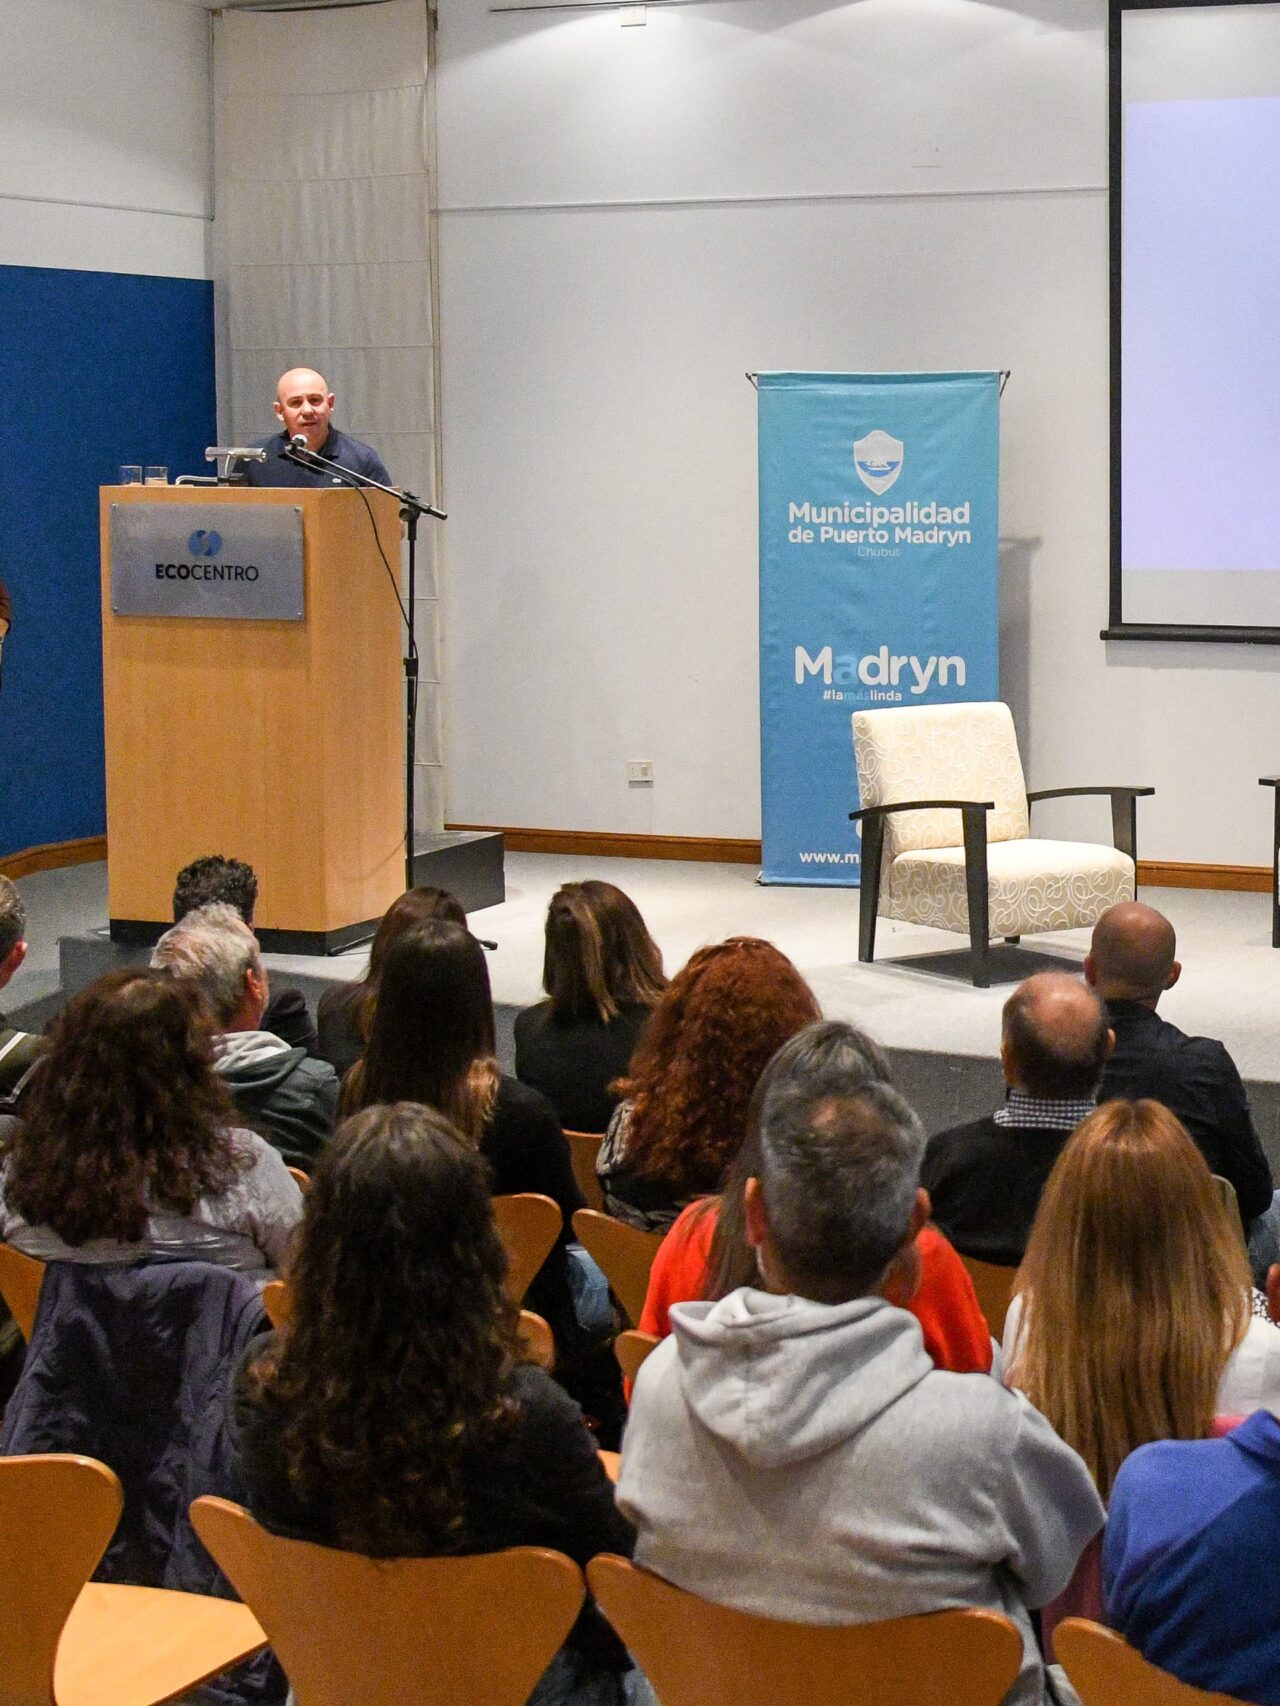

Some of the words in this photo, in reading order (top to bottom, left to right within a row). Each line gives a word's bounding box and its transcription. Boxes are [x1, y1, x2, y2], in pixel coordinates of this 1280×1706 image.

[788, 501, 970, 528] Municipalidad
[788, 526, 814, 544] de
[820, 526, 889, 544] Puerto
[895, 526, 971, 547] Madryn
[857, 546, 900, 558] Chubut
[155, 563, 259, 582] ECOCENTRO
[794, 645, 966, 694] Madryn
[799, 852, 861, 864] www.m
